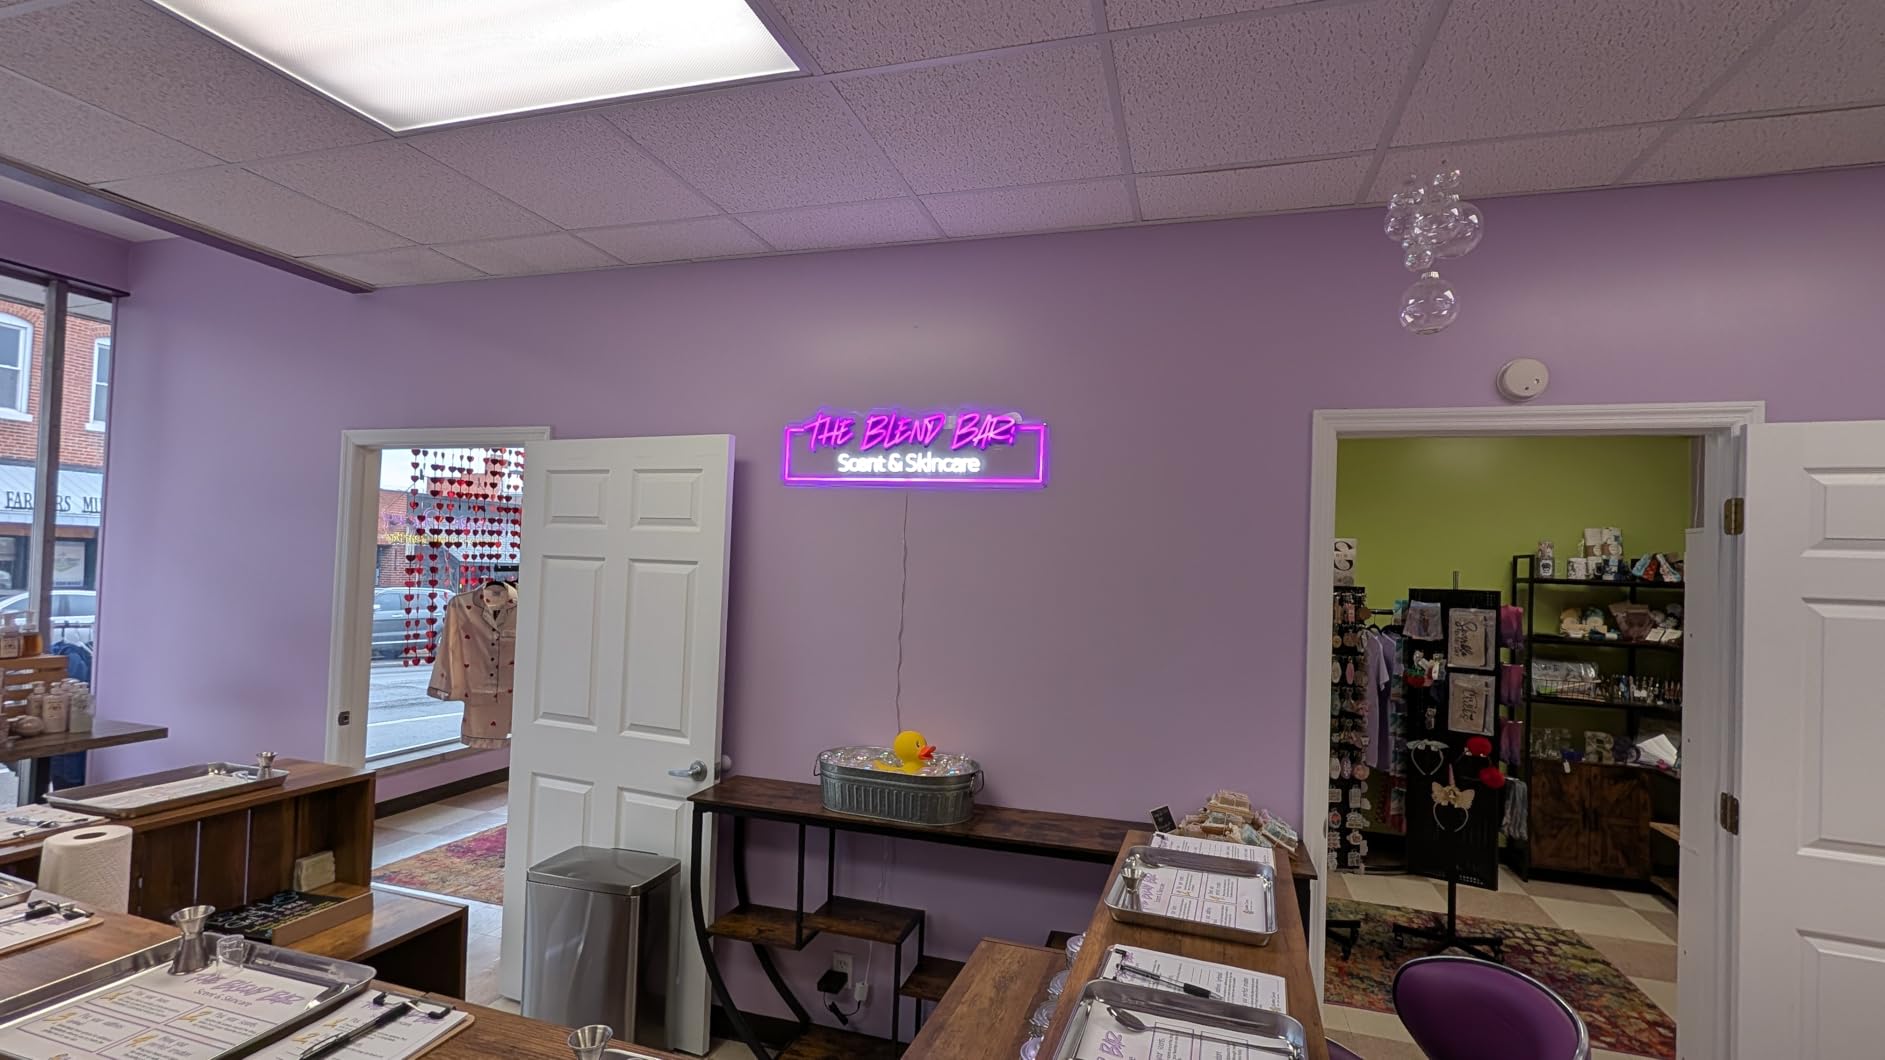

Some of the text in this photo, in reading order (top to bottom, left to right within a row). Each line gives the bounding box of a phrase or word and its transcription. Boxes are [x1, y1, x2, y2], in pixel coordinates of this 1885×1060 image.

[803, 412, 855, 452] THE
[860, 411, 946, 450] BLEND
[837, 451, 981, 473] Scent & Skincare
[5, 490, 72, 512] FARRS
